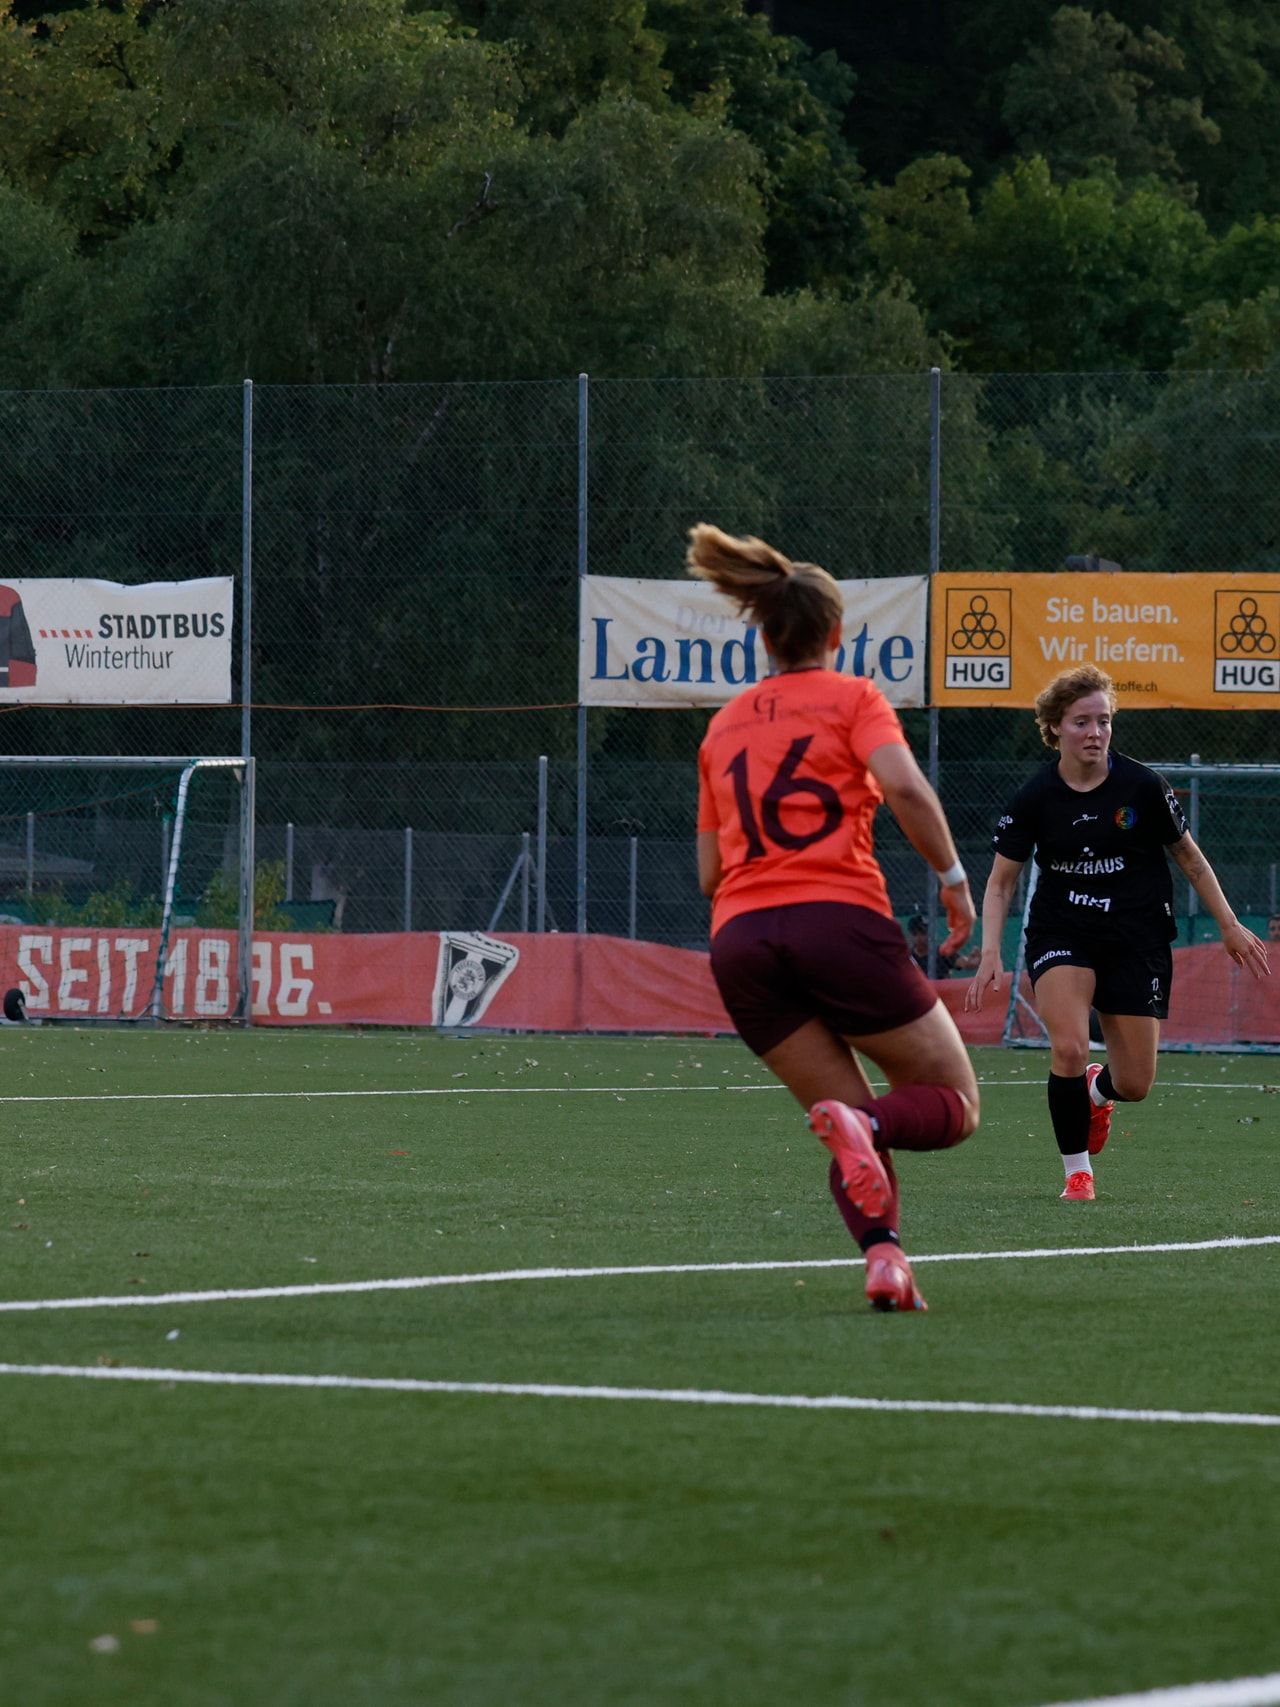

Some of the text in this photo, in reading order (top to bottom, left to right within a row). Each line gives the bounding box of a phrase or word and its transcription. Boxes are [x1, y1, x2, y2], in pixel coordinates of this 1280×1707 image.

[1046, 597, 1179, 624] Sie bauen.
[98, 612, 226, 640] STADTBUS
[65, 643, 174, 670] Winterthur
[590, 617, 915, 685] Landte
[1039, 635, 1185, 663] Wir liefern.
[952, 662, 1005, 683] HUG
[1221, 665, 1275, 686] HUG
[1111, 680, 1158, 693] stoffe.ch
[722, 734, 845, 864] 16
[1050, 856, 1126, 875] SALZHAUS
[18, 936, 150, 1015] SEIT
